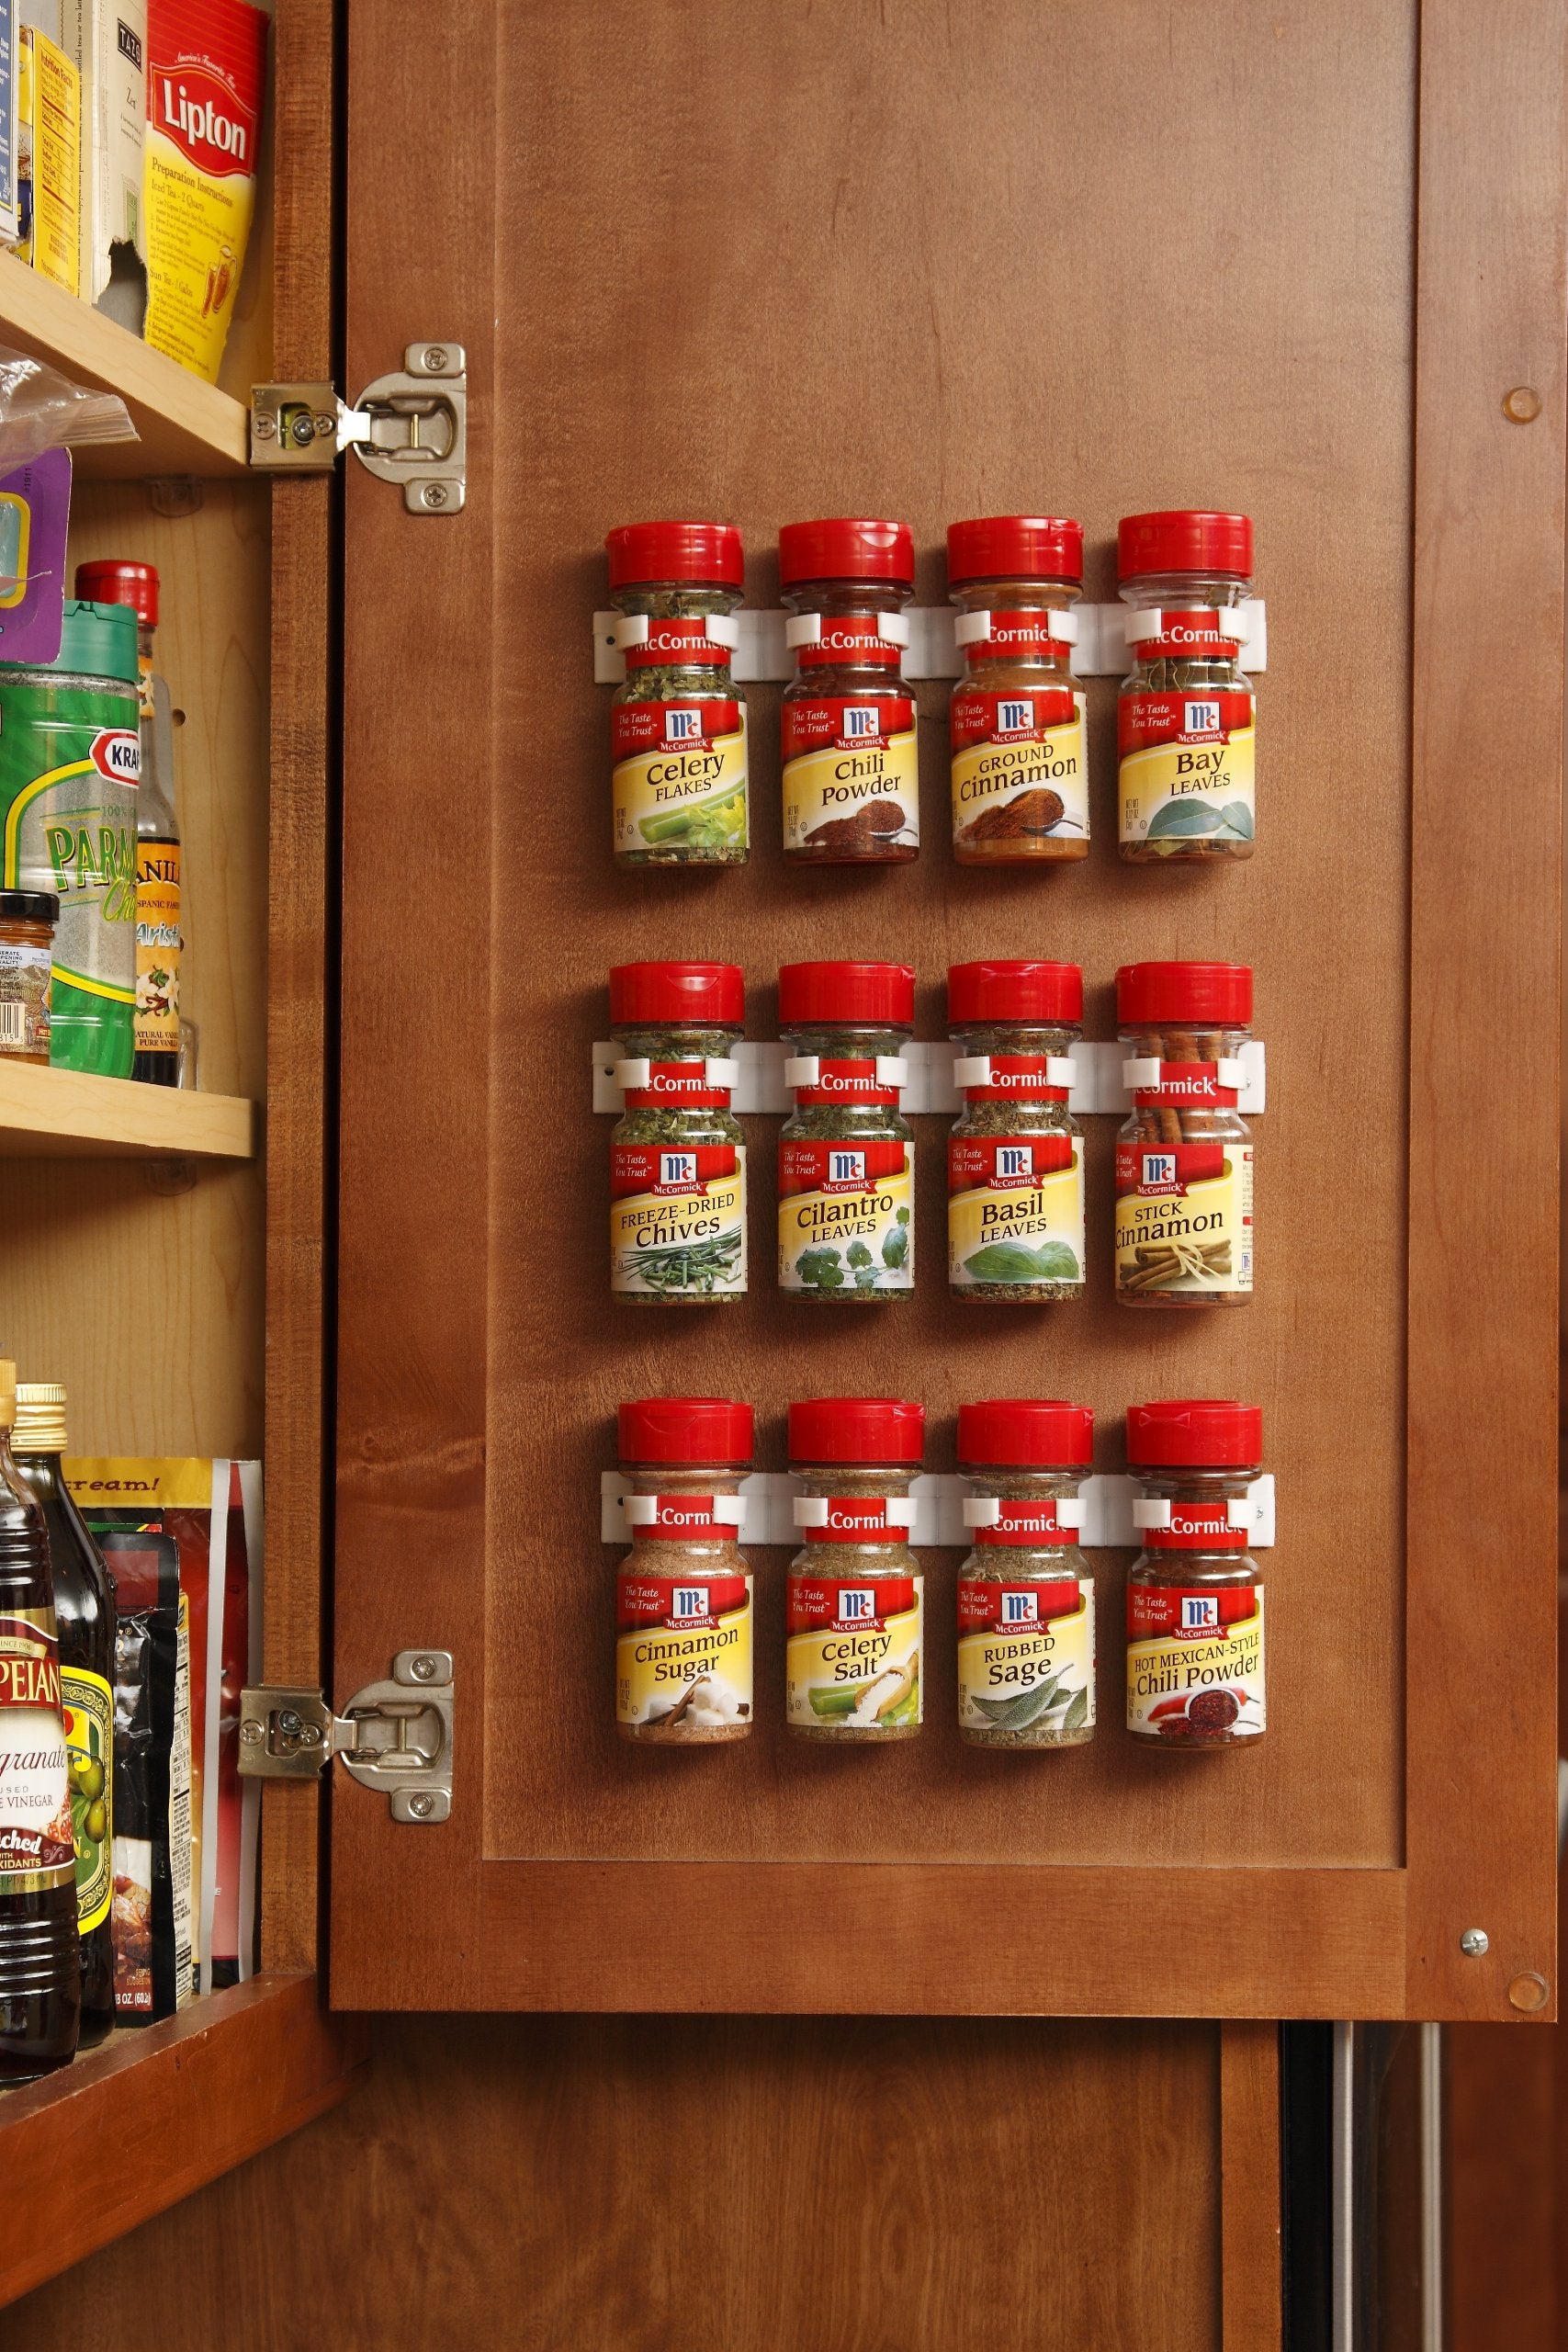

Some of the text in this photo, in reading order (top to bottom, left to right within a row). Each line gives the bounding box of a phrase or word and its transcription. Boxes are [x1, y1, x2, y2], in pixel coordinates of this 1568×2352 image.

[164, 79, 246, 160] Lipton
[152, 157, 233, 208] Preparation Instructions
[152, 178, 165, 194] Iced
[166, 184, 177, 198] Tea
[150, 266, 162, 281] Sun
[619, 714, 651, 724] The Taste
[793, 711, 828, 721] The Taste
[964, 706, 983, 715] Taste
[1133, 705, 1169, 716] The Taste
[660, 739, 707, 752] McCormick
[837, 737, 885, 749] McCormick
[991, 730, 1039, 742] McCormick
[1178, 731, 1225, 743] McCormick
[835, 753, 885, 780] Chili
[979, 745, 1054, 774] GROUND
[1176, 751, 1225, 775] Bay
[647, 754, 725, 786] Celery
[961, 757, 1077, 802] Cinnamon
[656, 777, 712, 802] FLAKES
[821, 775, 901, 806] Powder
[1170, 773, 1231, 797] LEAVES
[616, 1155, 646, 1164] The Taste
[784, 1152, 815, 1162] The Taste
[964, 1149, 982, 1159] Taste
[654, 1183, 702, 1194] McCormick
[822, 1181, 870, 1192] McCormick
[989, 1177, 1037, 1188] McCormick
[1137, 1183, 1183, 1195] McCormick
[621, 1193, 735, 1230] FREEZE-DRIED
[796, 1195, 893, 1228] Cilantro
[981, 1193, 1043, 1226] Basil
[1135, 1202, 1183, 1222] STICK
[636, 1216, 720, 1248] Chives
[812, 1218, 876, 1243] LEAVES
[980, 1218, 1047, 1244] LEAVES
[626, 1586, 659, 1597] The Taste
[794, 1589, 824, 1600] The Taste
[970, 1593, 987, 1602] Taste
[1134, 1596, 1167, 1607] The Taste
[666, 1617, 715, 1628] McCormick
[831, 1620, 880, 1631] McCormick
[996, 1622, 1044, 1634] McCormick
[1175, 1627, 1224, 1638] McCormick
[635, 1628, 739, 1664] Cinnamon
[821, 1634, 892, 1662] Celery
[984, 1637, 1055, 1663] RUBBED
[1135, 1632, 1259, 1672] HOT MEXICAN-STYLE
[654, 1655, 719, 1682] Sugar
[835, 1658, 877, 1681] Salt
[988, 1658, 1052, 1686] Sage
[1137, 1654, 1258, 1697] Chili Powder
[7, 1795, 53, 1808] VINEGAR
[0, 1829, 42, 1855] ched
